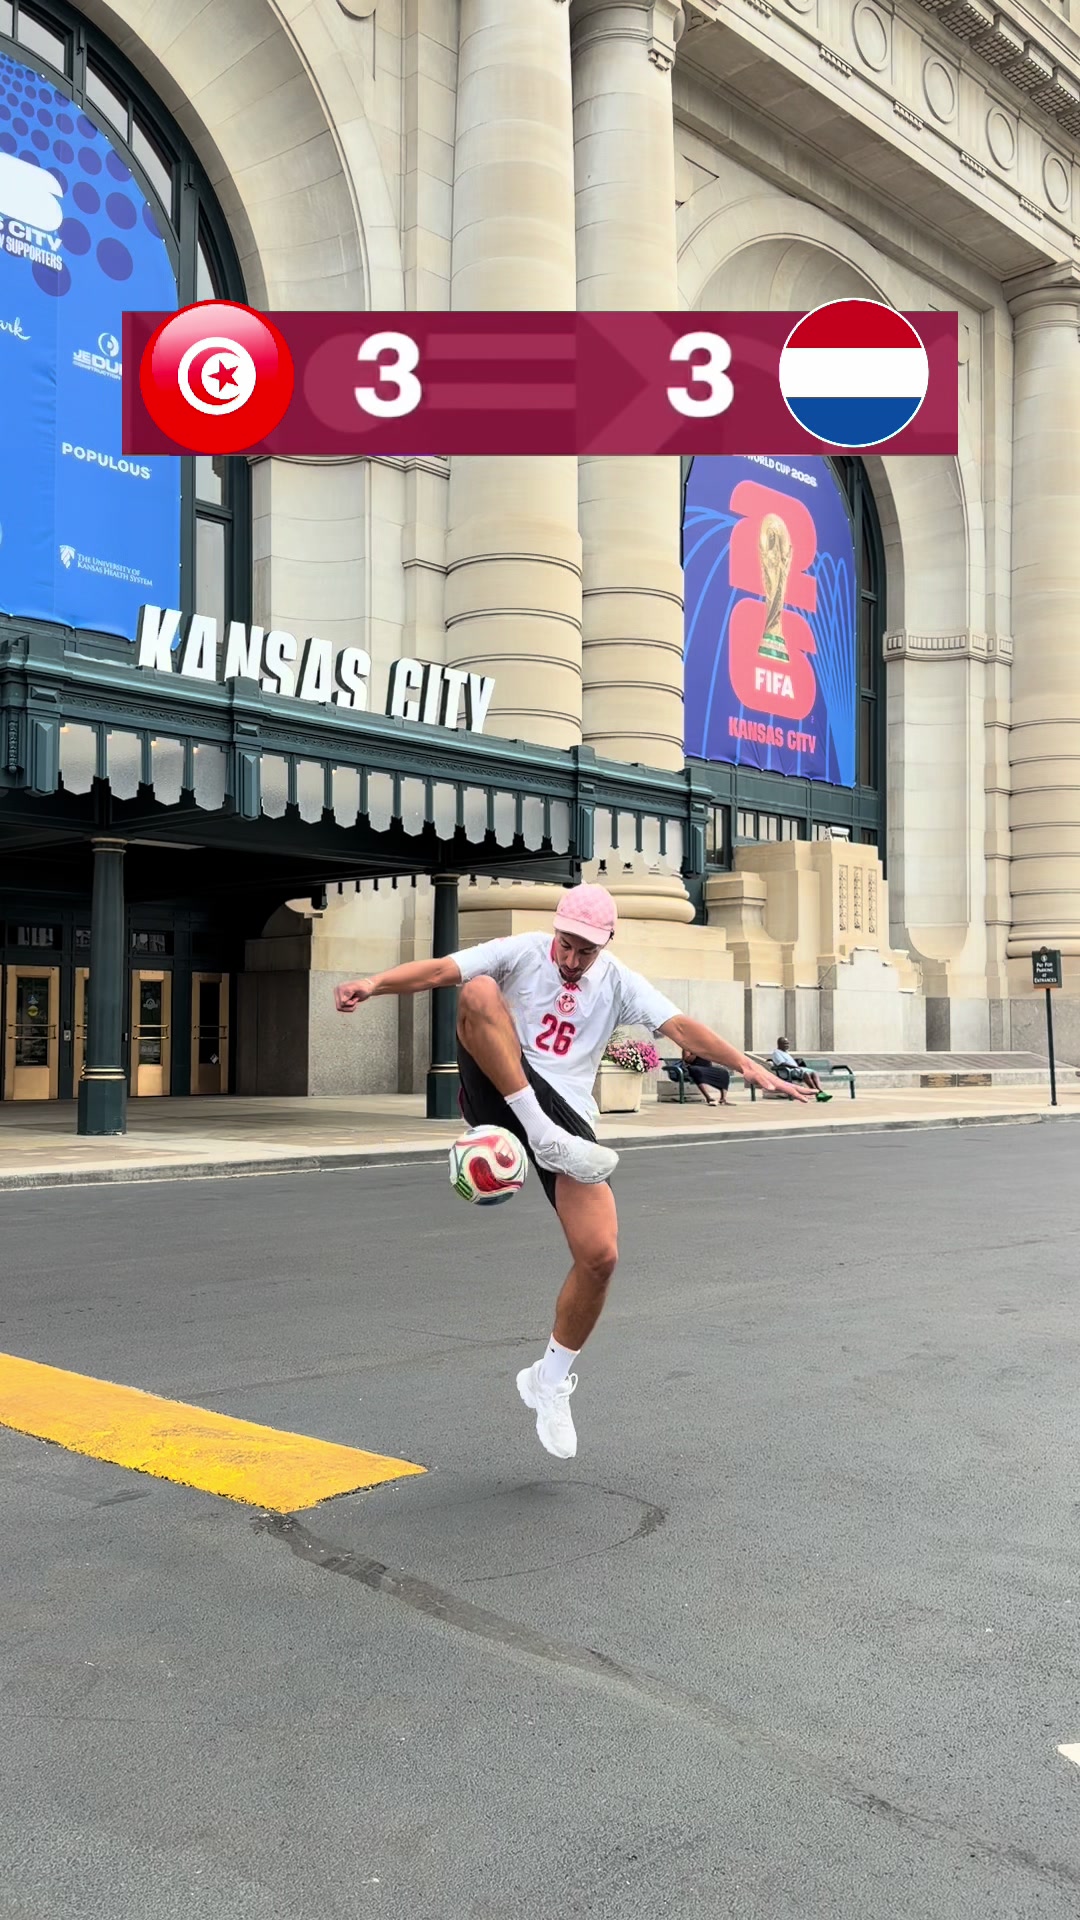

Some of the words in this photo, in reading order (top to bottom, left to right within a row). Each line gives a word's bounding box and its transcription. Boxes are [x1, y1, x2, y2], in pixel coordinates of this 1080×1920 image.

[5, 235, 63, 271] SUPPORTERS
[8, 220, 63, 252] CITY
[62, 442, 150, 480] POPULOUS
[775, 461, 791, 476] CUP
[790, 468, 818, 488] 2026
[77, 553, 91, 564] THE
[92, 557, 132, 572] UNIVERSITY
[77, 561, 103, 574] KANSAS
[103, 567, 129, 580] HEALTH
[129, 574, 153, 586] SYSTEM
[136, 603, 372, 712] KANSAS
[386, 657, 496, 735] CITY
[755, 667, 795, 700] FIFA
[728, 716, 784, 748] KANSAS
[787, 729, 817, 754] CITY
[535, 1012, 576, 1056] 26
